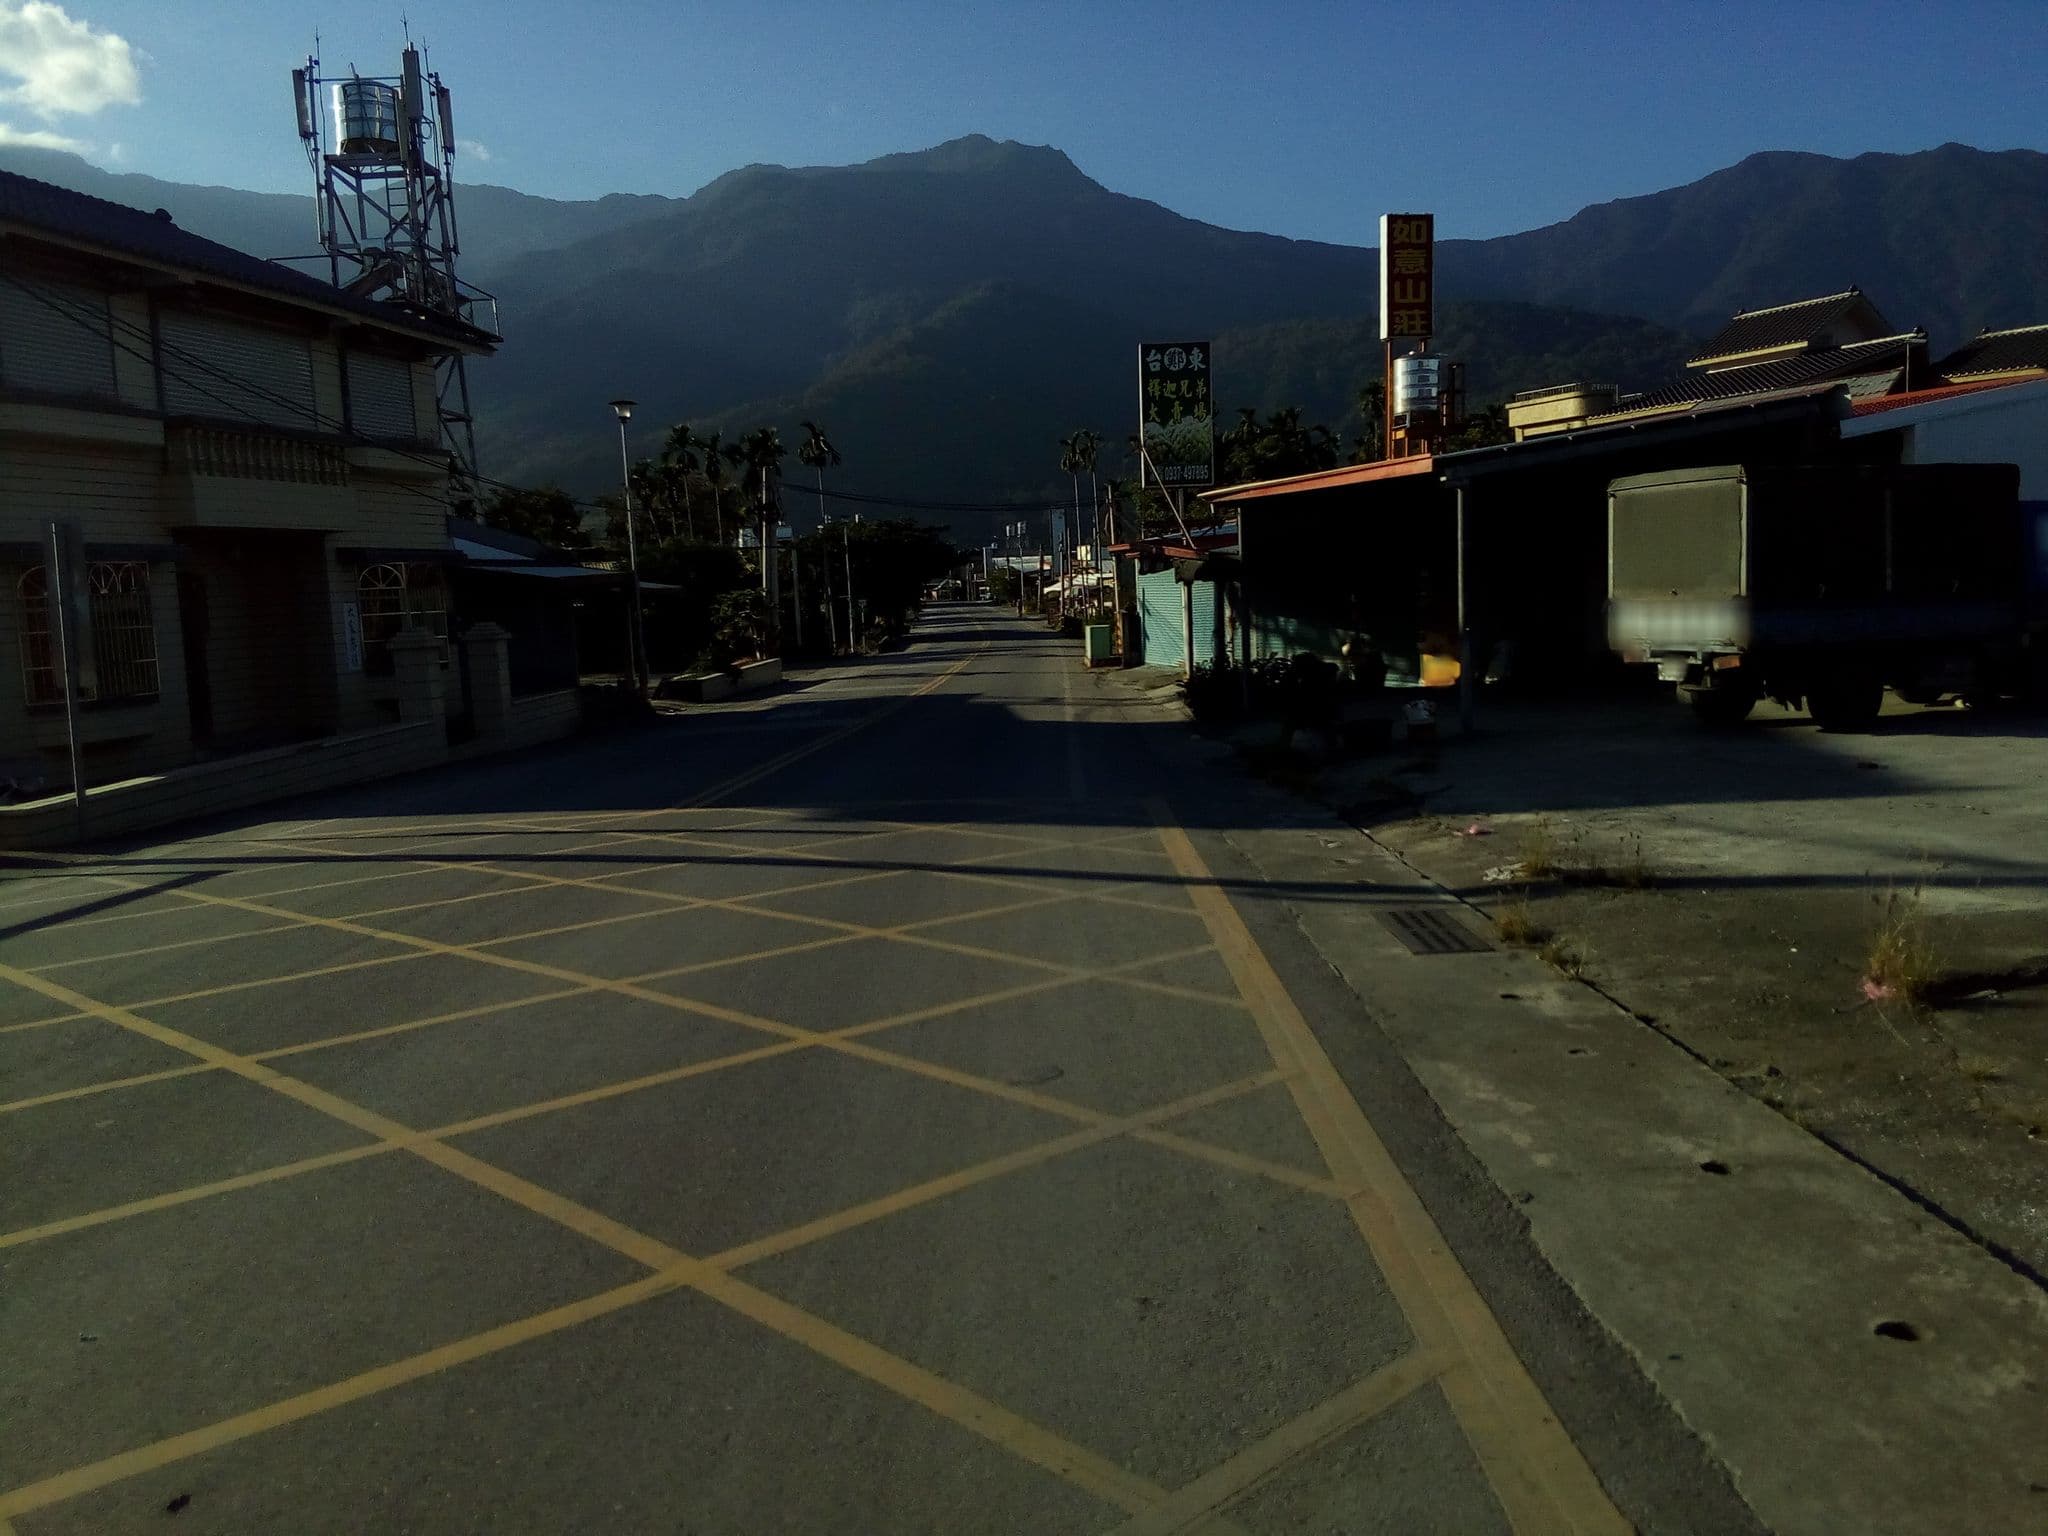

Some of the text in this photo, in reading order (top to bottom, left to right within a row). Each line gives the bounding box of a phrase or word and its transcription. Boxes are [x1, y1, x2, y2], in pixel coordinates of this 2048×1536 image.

[1392, 220, 1427, 335] 如意山莊
[1147, 378, 1206, 401] 釋迦兄弟
